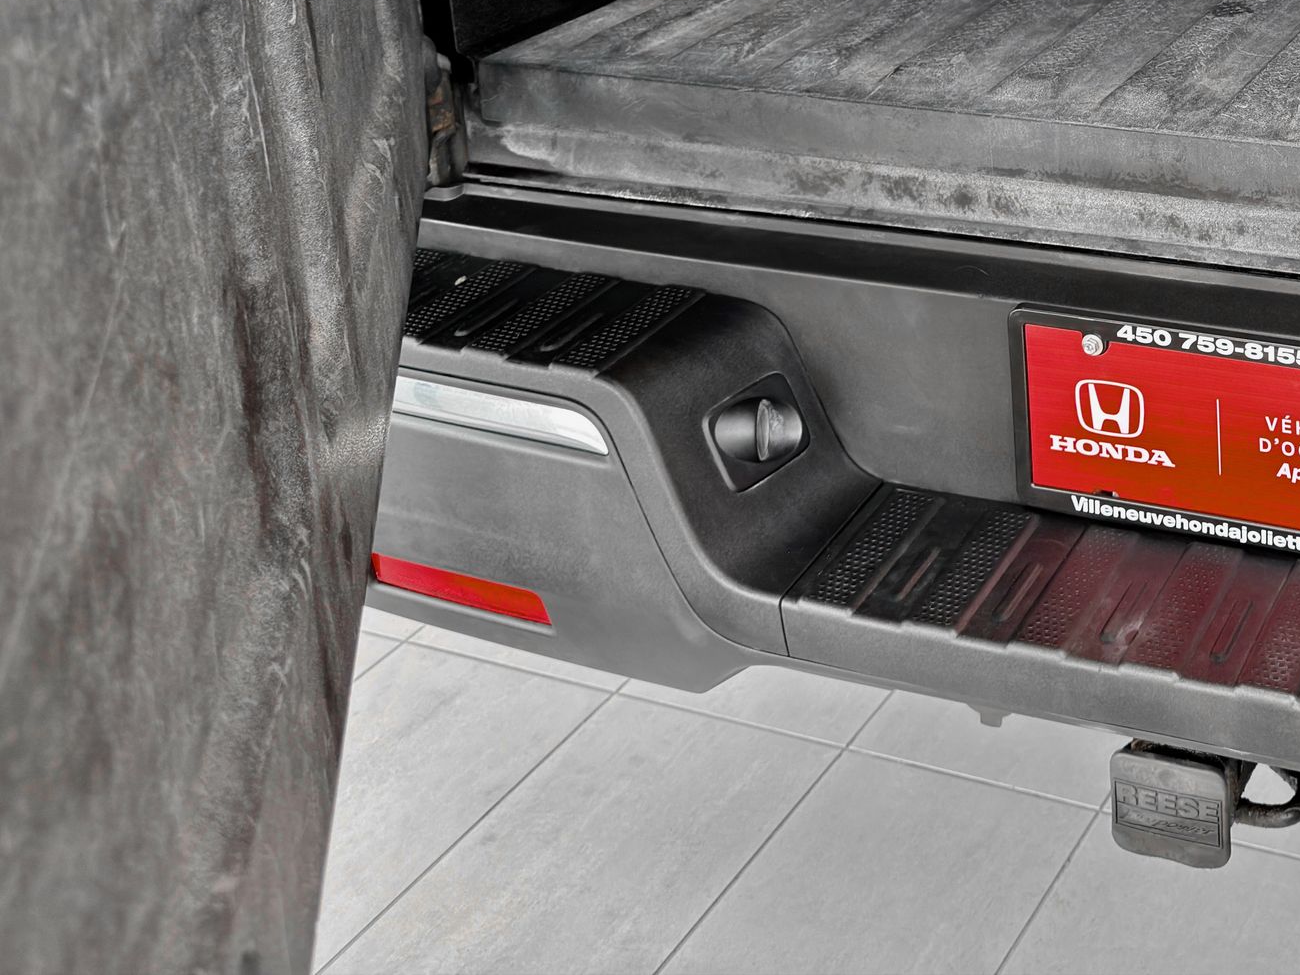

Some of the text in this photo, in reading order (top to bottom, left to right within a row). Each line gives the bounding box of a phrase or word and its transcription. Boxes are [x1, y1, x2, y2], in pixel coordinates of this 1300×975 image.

[1117, 325, 1172, 346] 450
[1050, 434, 1175, 467] HONDA
[1117, 783, 1220, 823] REESE
